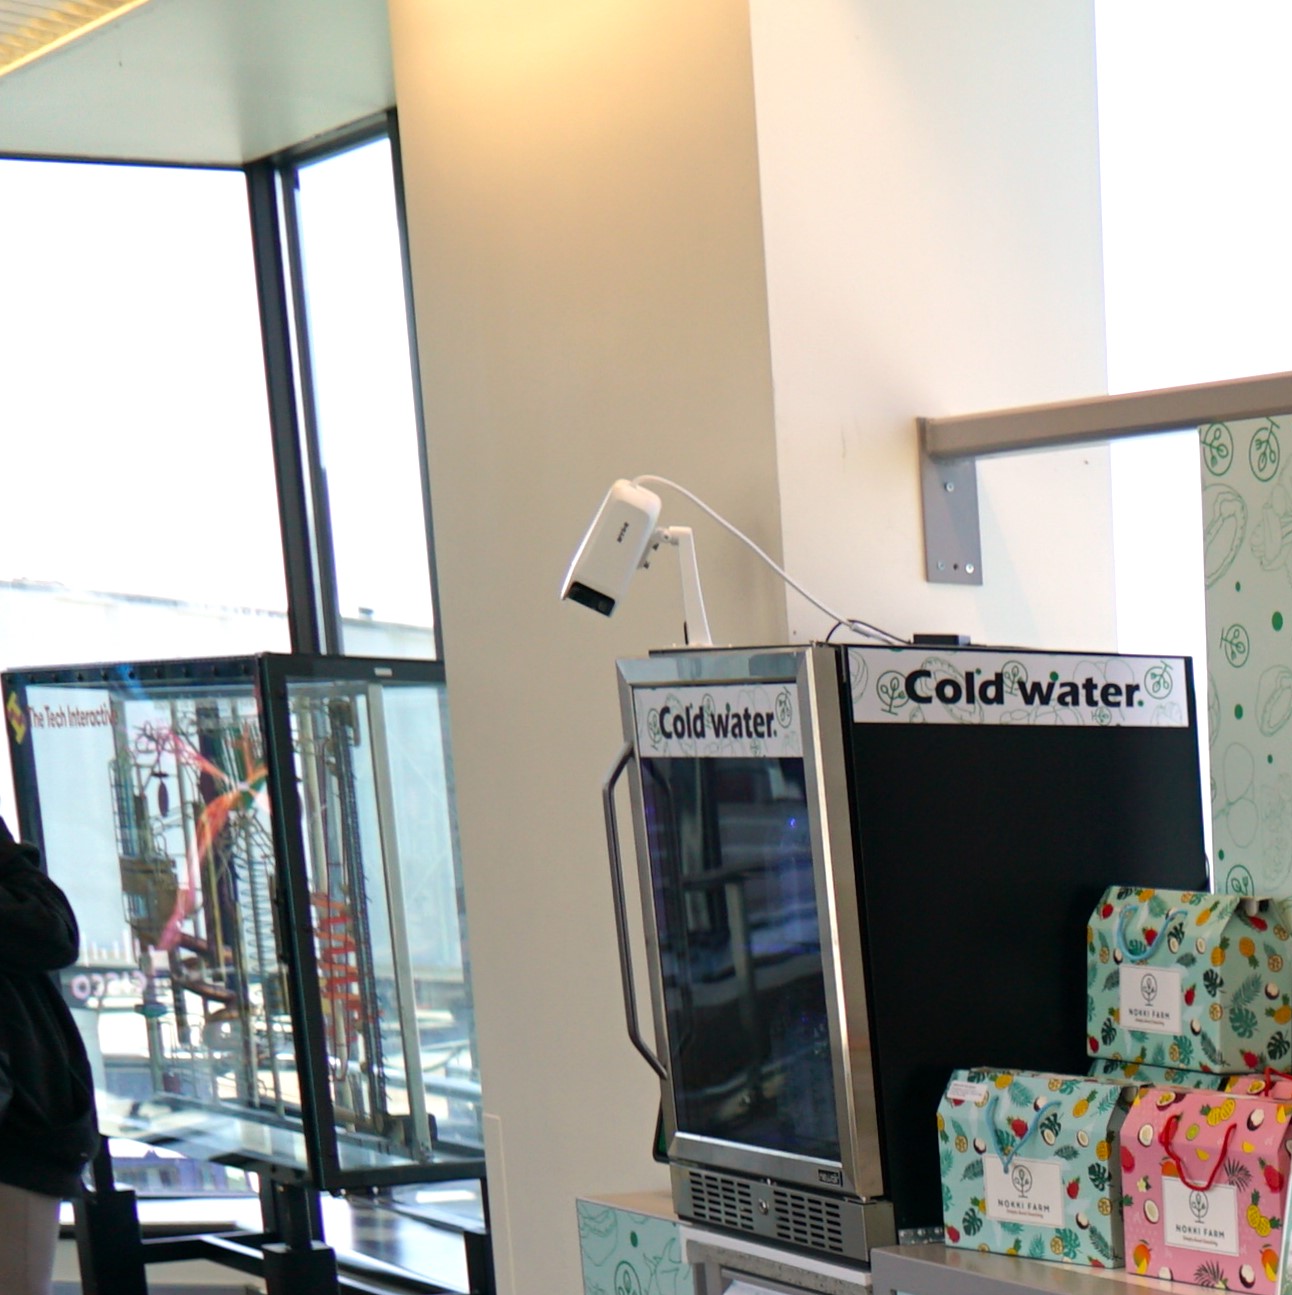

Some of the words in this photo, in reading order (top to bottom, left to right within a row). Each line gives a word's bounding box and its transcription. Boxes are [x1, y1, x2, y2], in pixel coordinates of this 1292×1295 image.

[905, 670, 1003, 705] Cold
[45, 705, 66, 728] Tech
[658, 705, 705, 740] Cold
